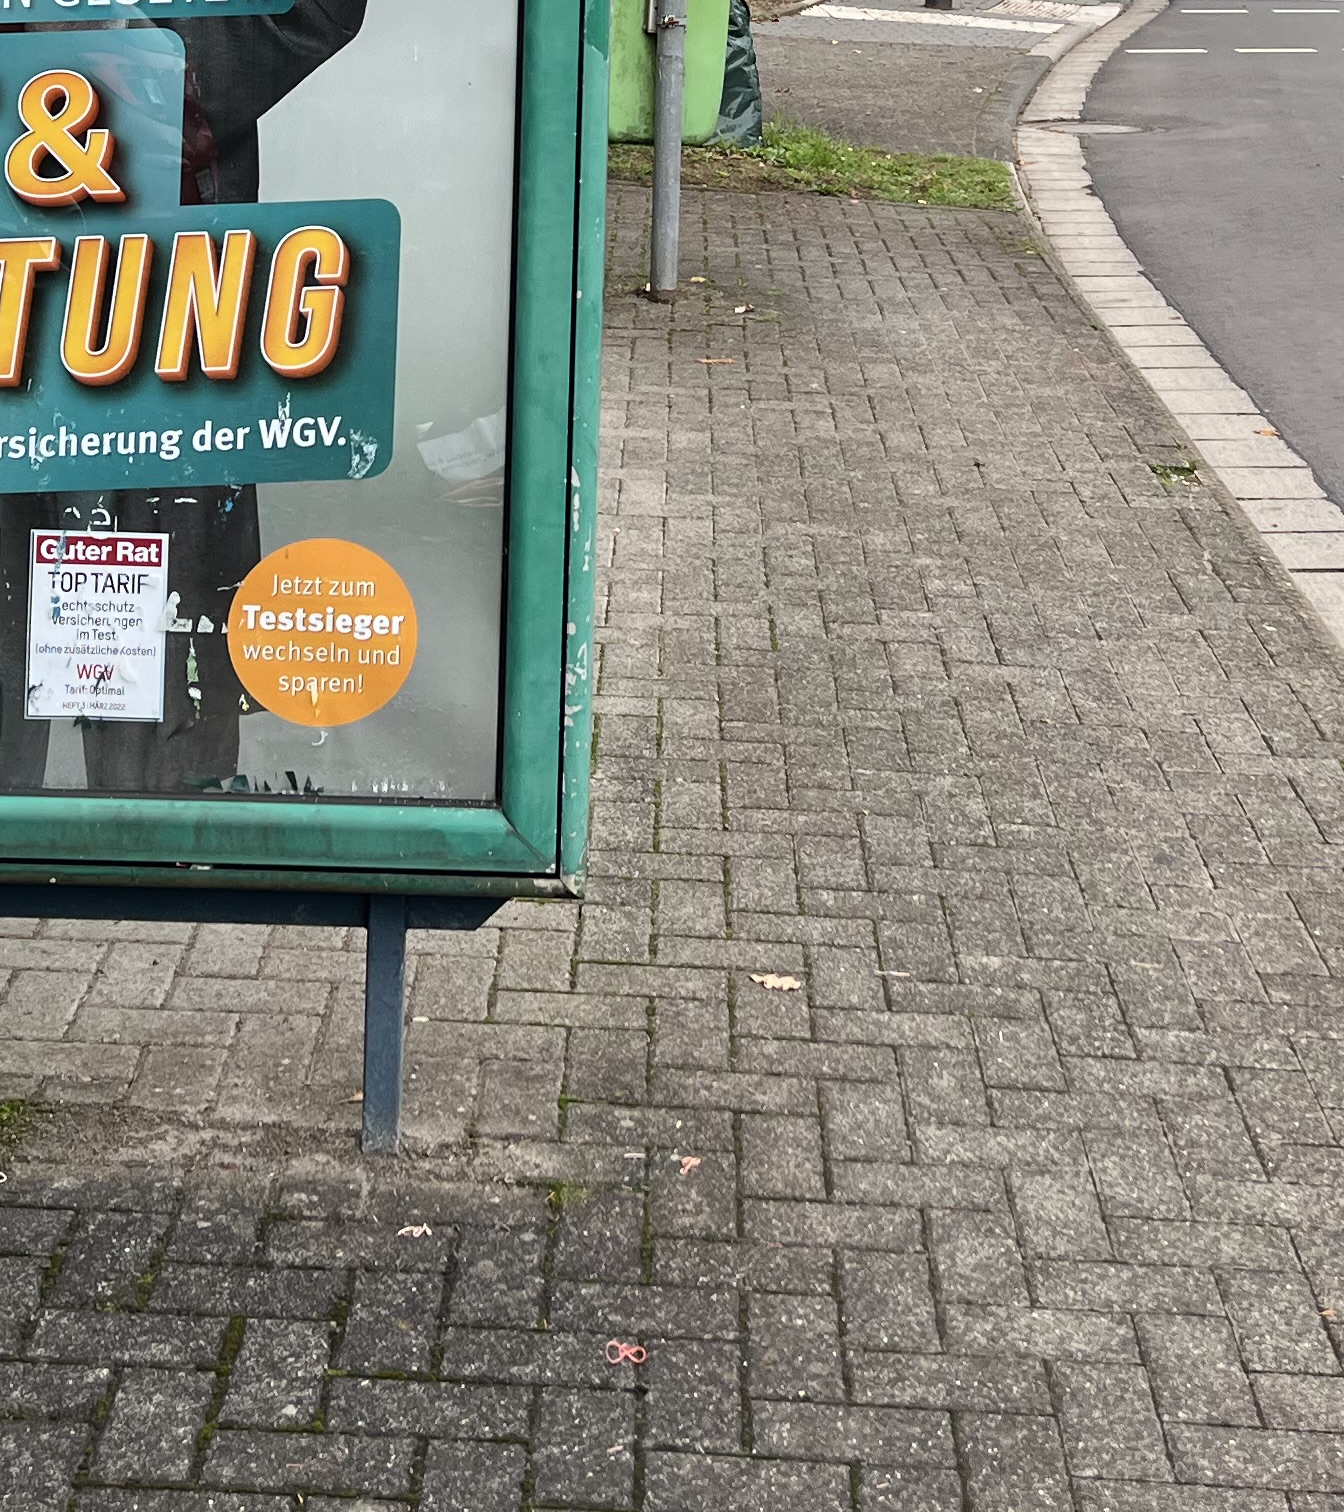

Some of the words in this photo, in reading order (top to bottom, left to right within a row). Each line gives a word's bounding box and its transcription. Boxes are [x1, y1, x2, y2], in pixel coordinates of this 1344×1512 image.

[4, 68, 127, 208] &
[192, 420, 251, 452] der
[258, 415, 347, 449] WGV.
[40, 539, 112, 561] Guter
[116, 541, 159, 563] Rat
[48, 571, 87, 593] TOP
[90, 572, 149, 595] TARIF
[271, 574, 323, 597] Jetzt
[328, 581, 376, 597] zum
[92, 628, 116, 641] Test
[242, 604, 405, 641] Testsieger
[243, 640, 350, 663] wechseln
[358, 645, 401, 665] und
[77, 663, 115, 680] WGV
[278, 674, 364, 696] sparen!
